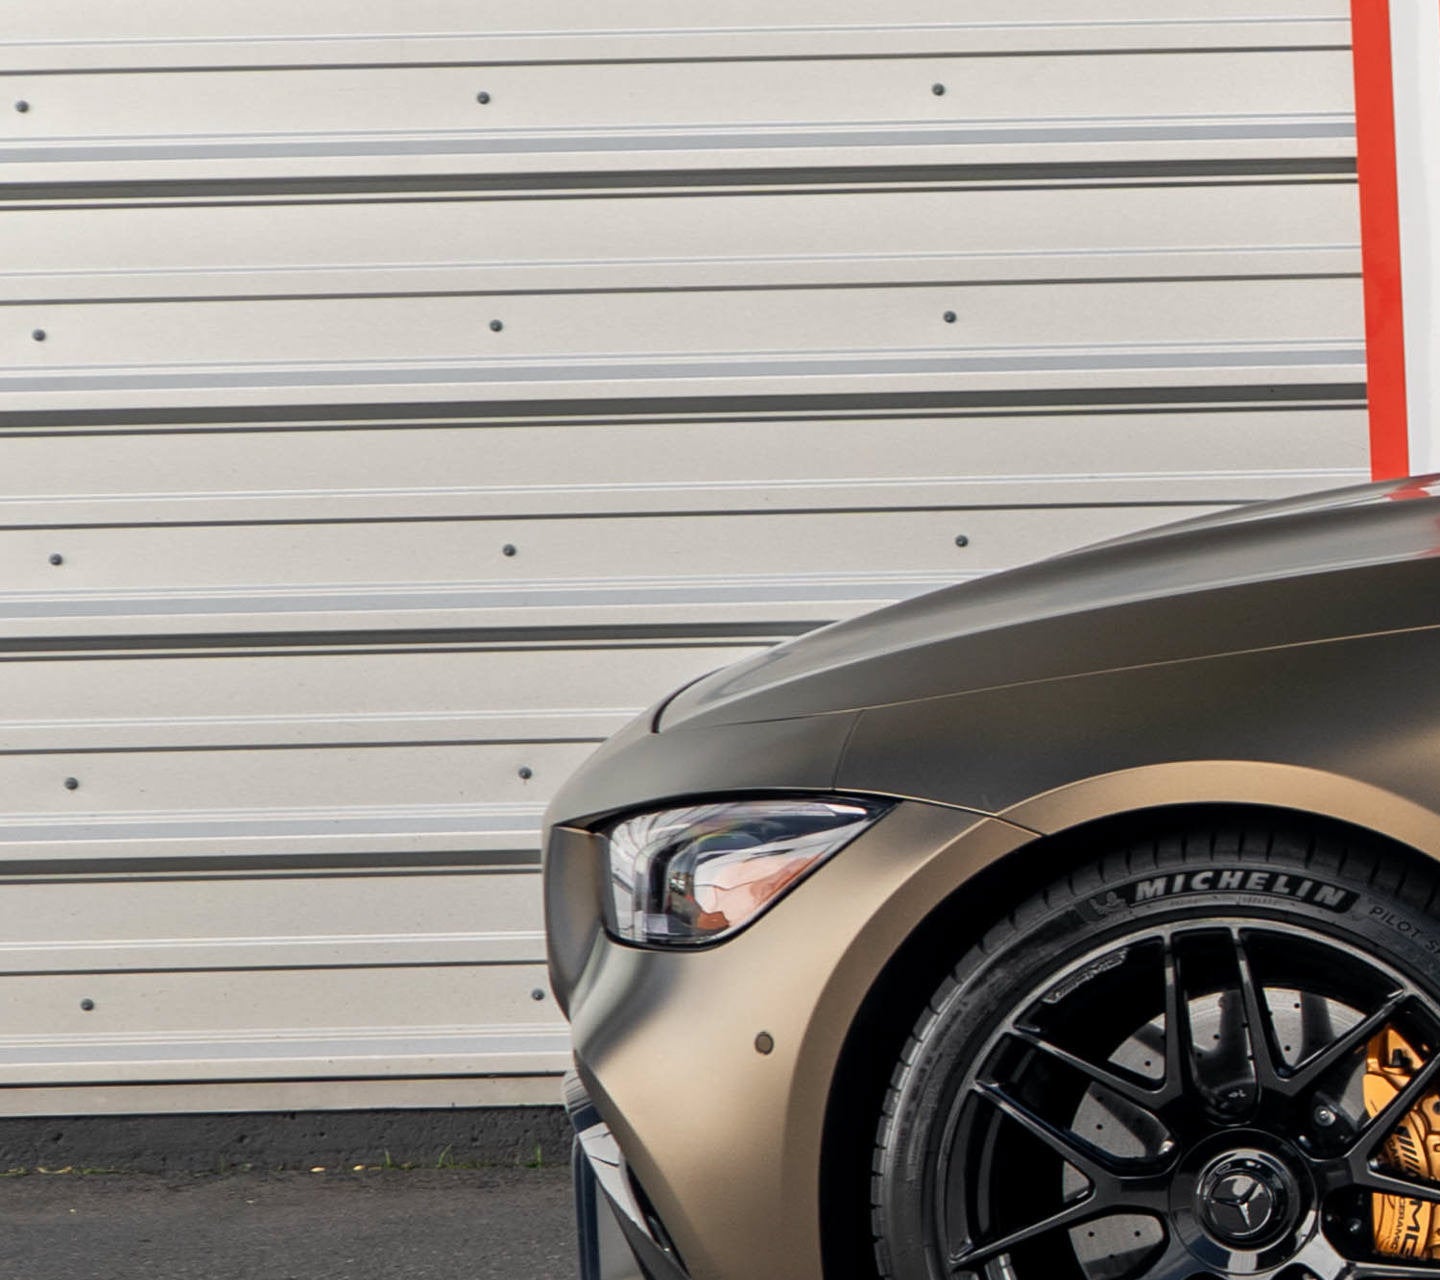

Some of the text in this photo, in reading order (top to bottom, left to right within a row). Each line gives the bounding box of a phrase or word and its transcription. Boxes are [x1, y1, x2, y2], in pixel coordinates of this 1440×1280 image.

[1133, 869, 1348, 909] MICHELIN
[1369, 905, 1424, 938] PILOT
[1400, 1198, 1423, 1258] MG
